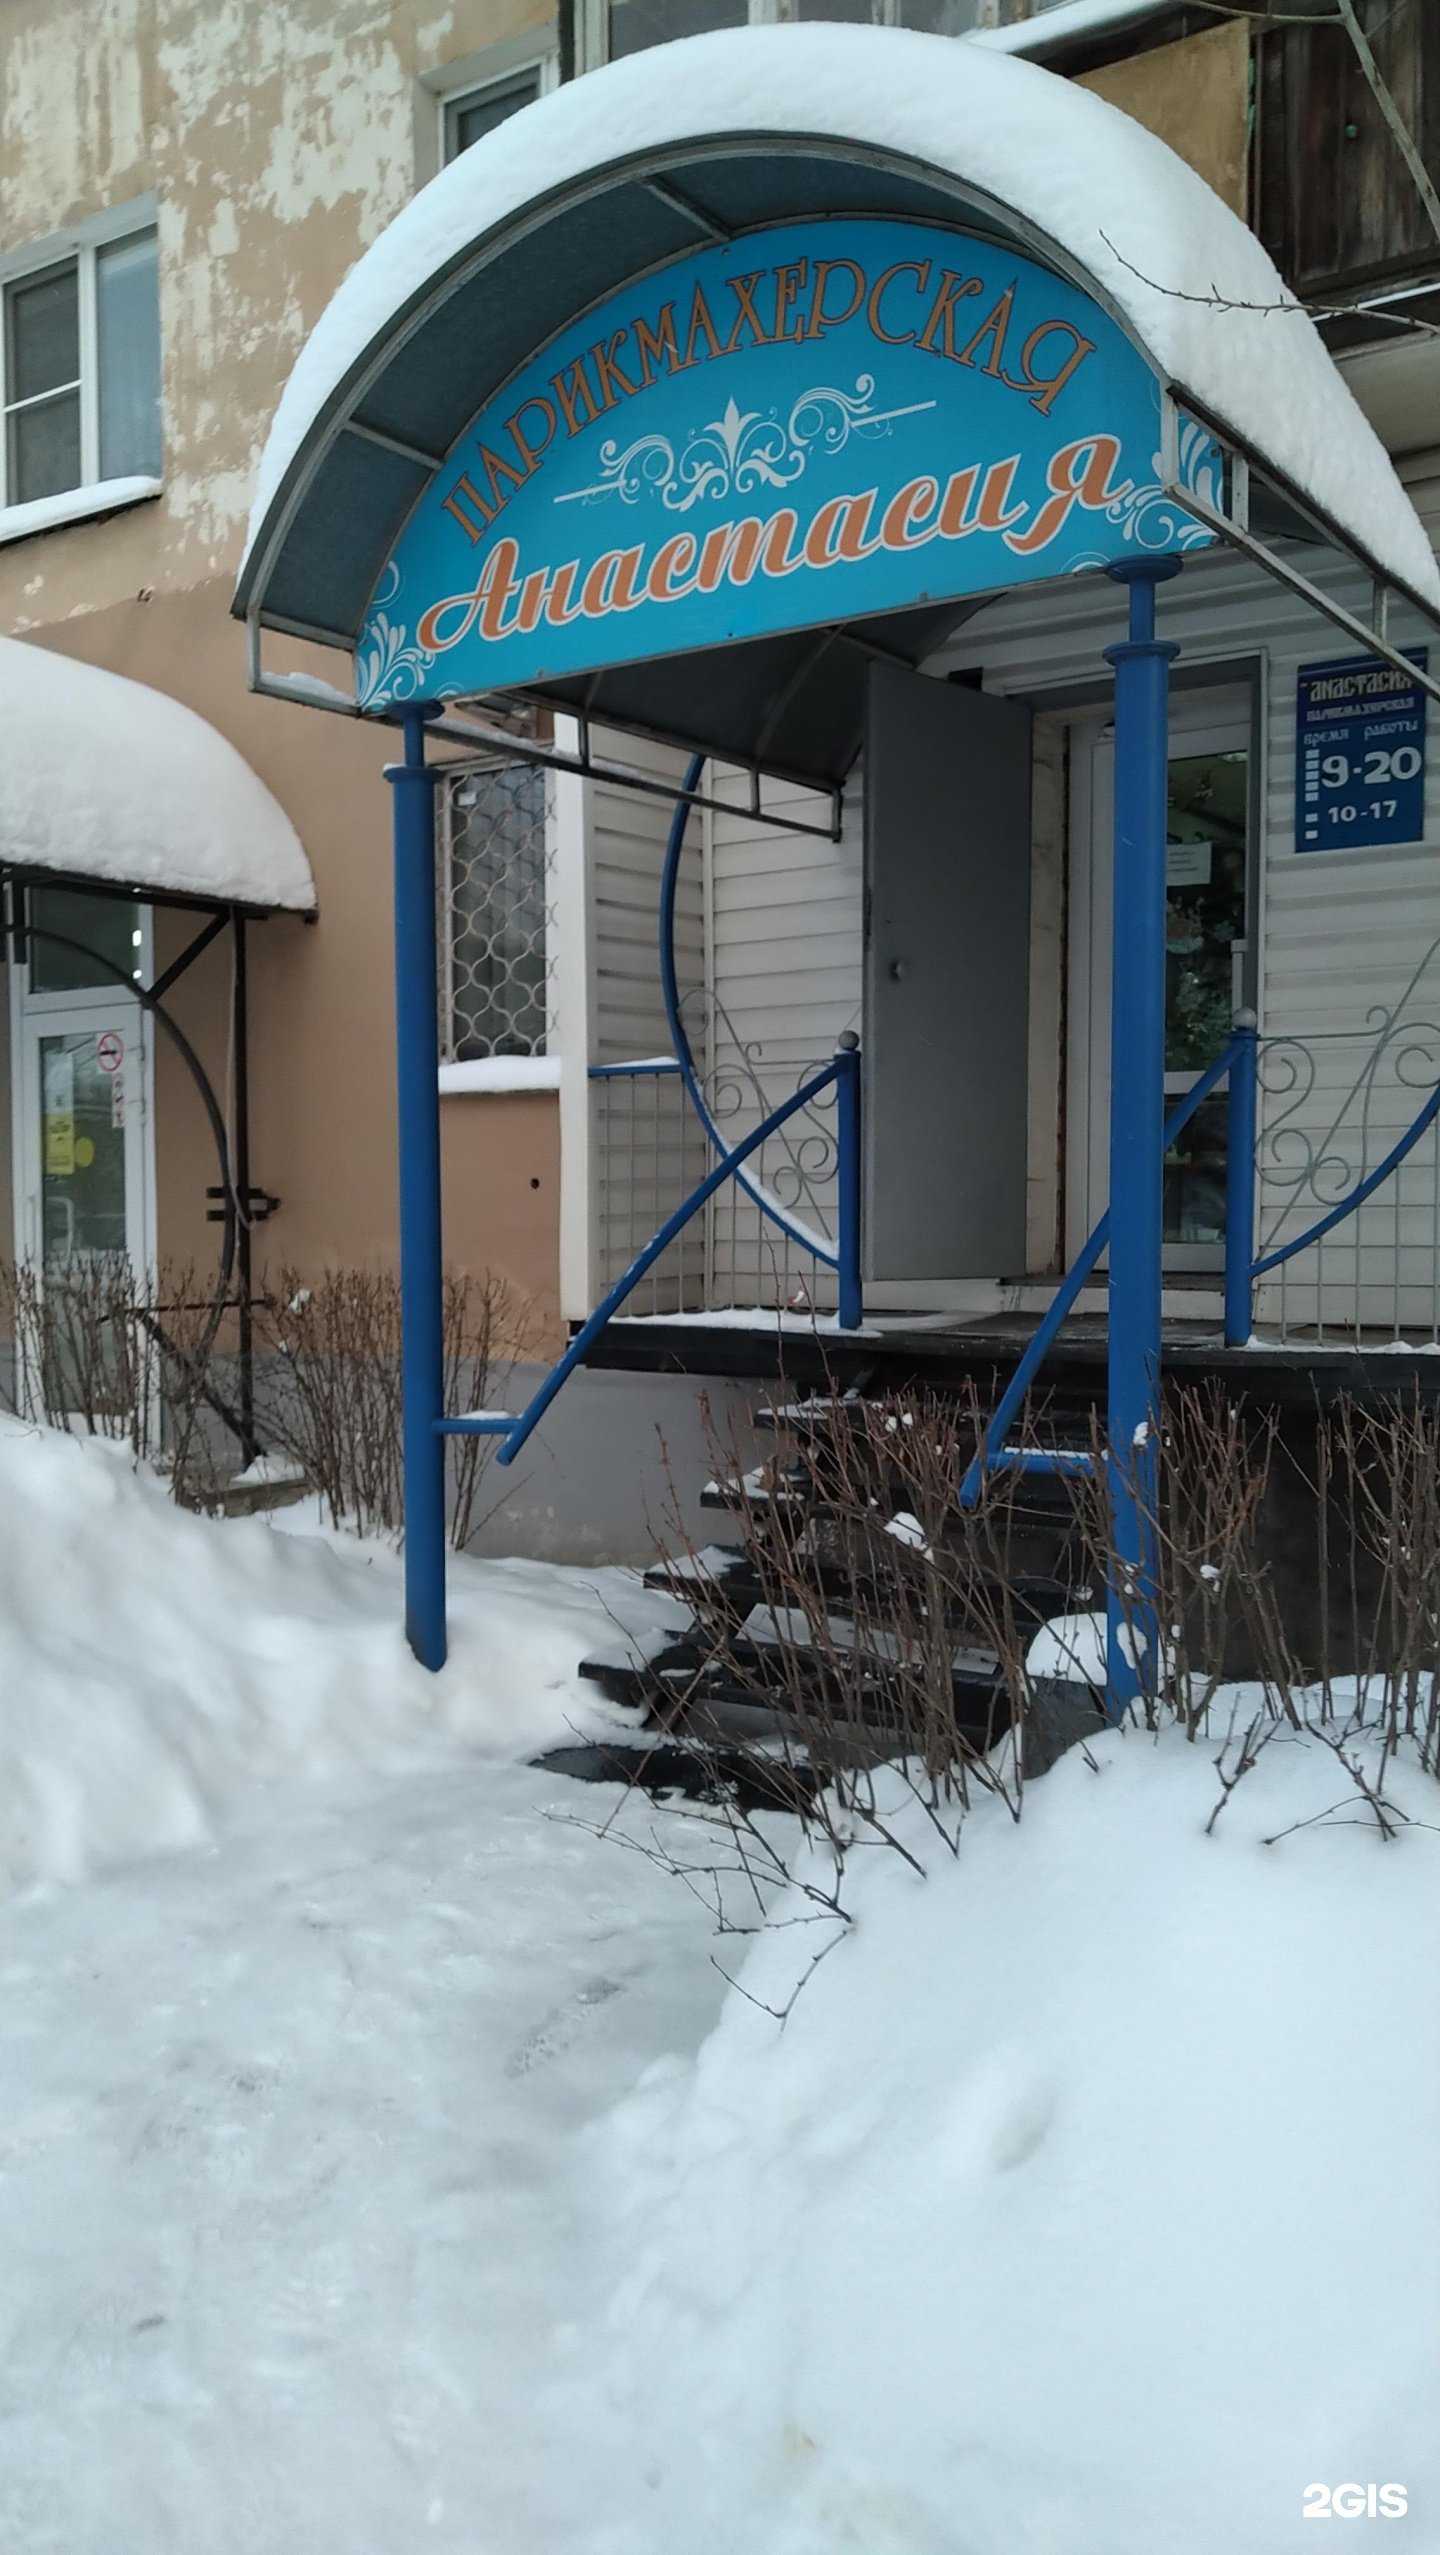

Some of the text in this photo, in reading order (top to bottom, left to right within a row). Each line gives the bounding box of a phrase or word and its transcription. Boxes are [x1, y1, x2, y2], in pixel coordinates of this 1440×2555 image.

[440, 256, 1097, 547] ПАРИКМАХЕРСКАЯ
[414, 433, 1131, 655] Анастасия
[1321, 746, 1422, 788] 9-20
[1328, 800, 1398, 823] 10-17
